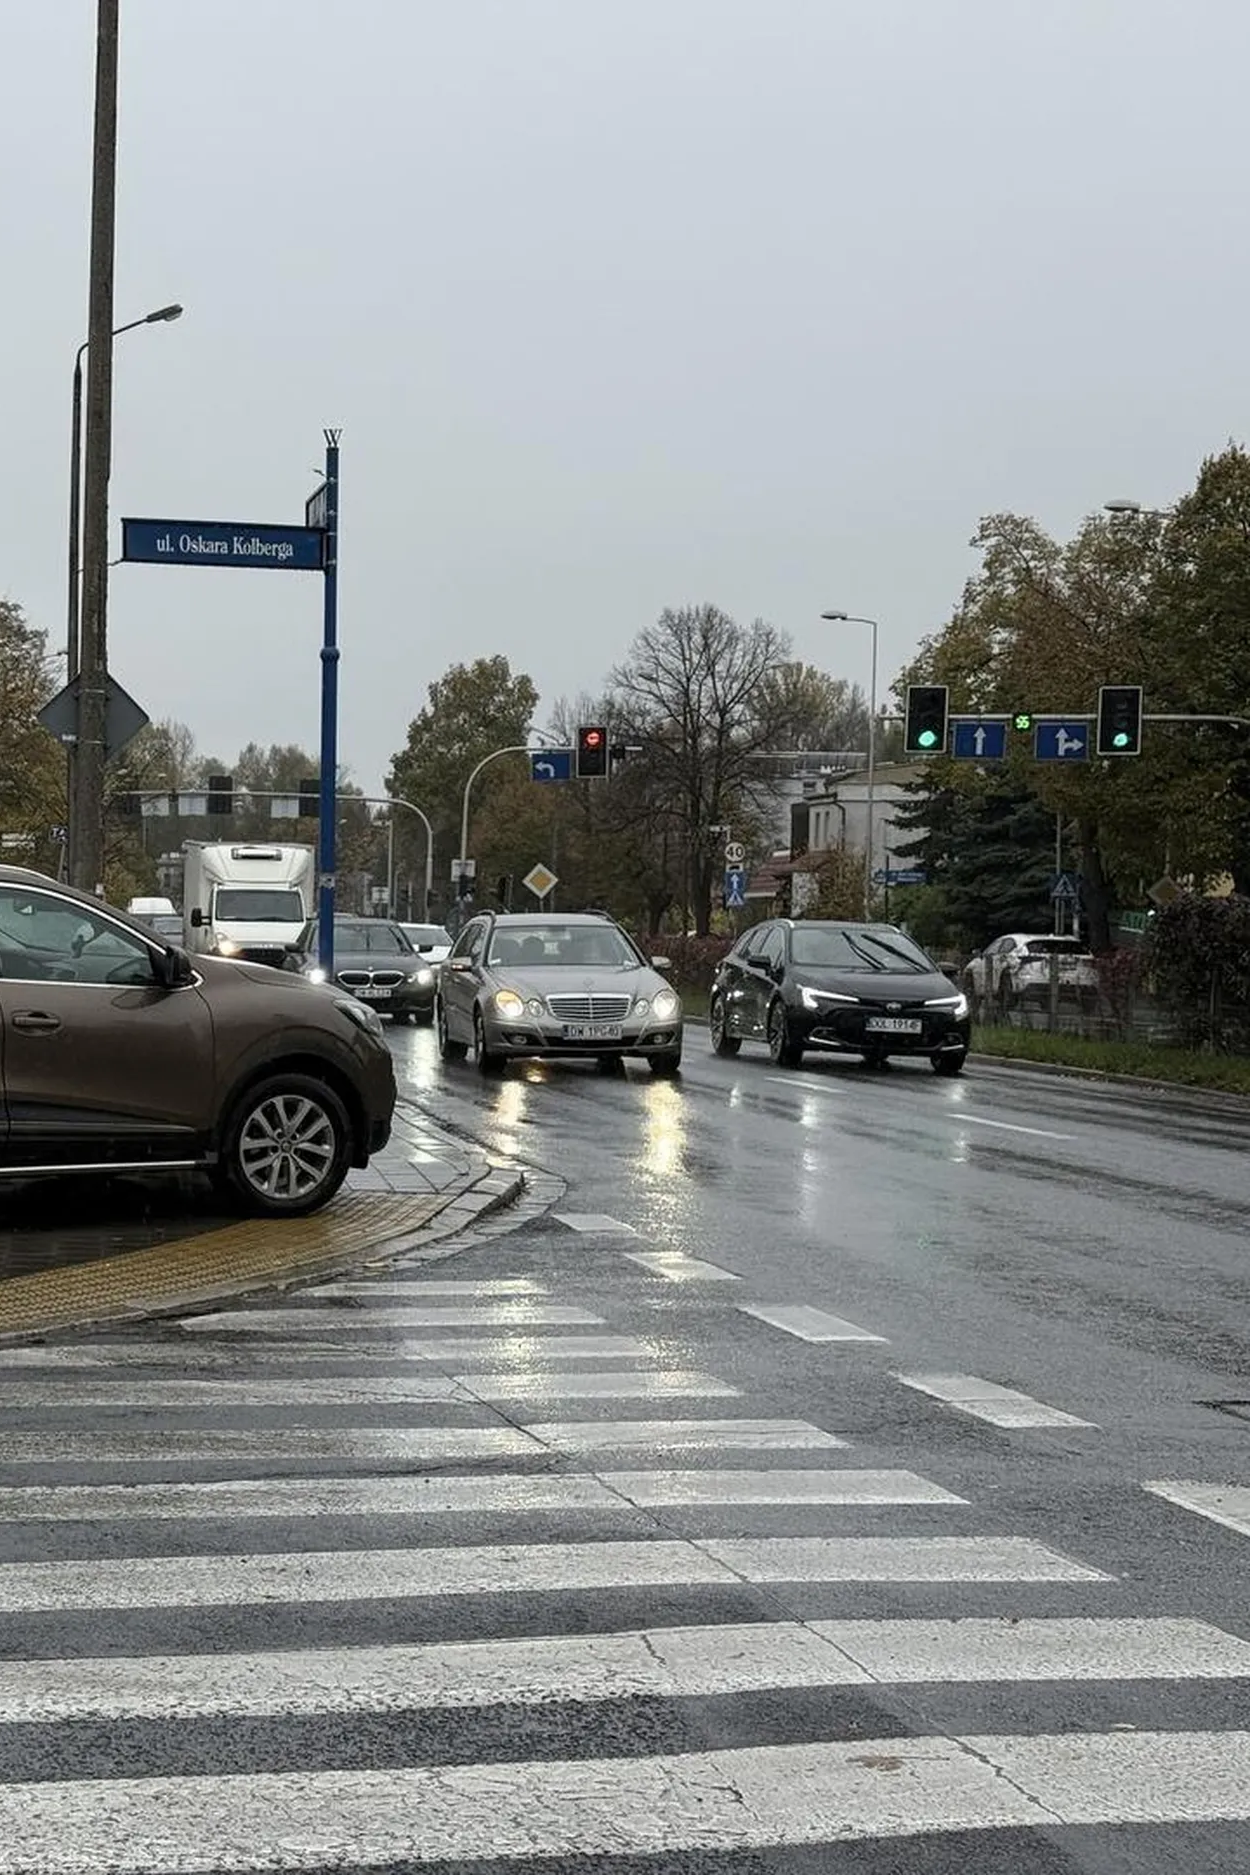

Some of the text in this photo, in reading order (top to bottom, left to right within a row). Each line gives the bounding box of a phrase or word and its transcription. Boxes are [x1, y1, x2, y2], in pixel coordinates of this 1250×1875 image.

[156, 534, 294, 560] ul. Oskara Kolberga
[726, 845, 744, 858] 40
